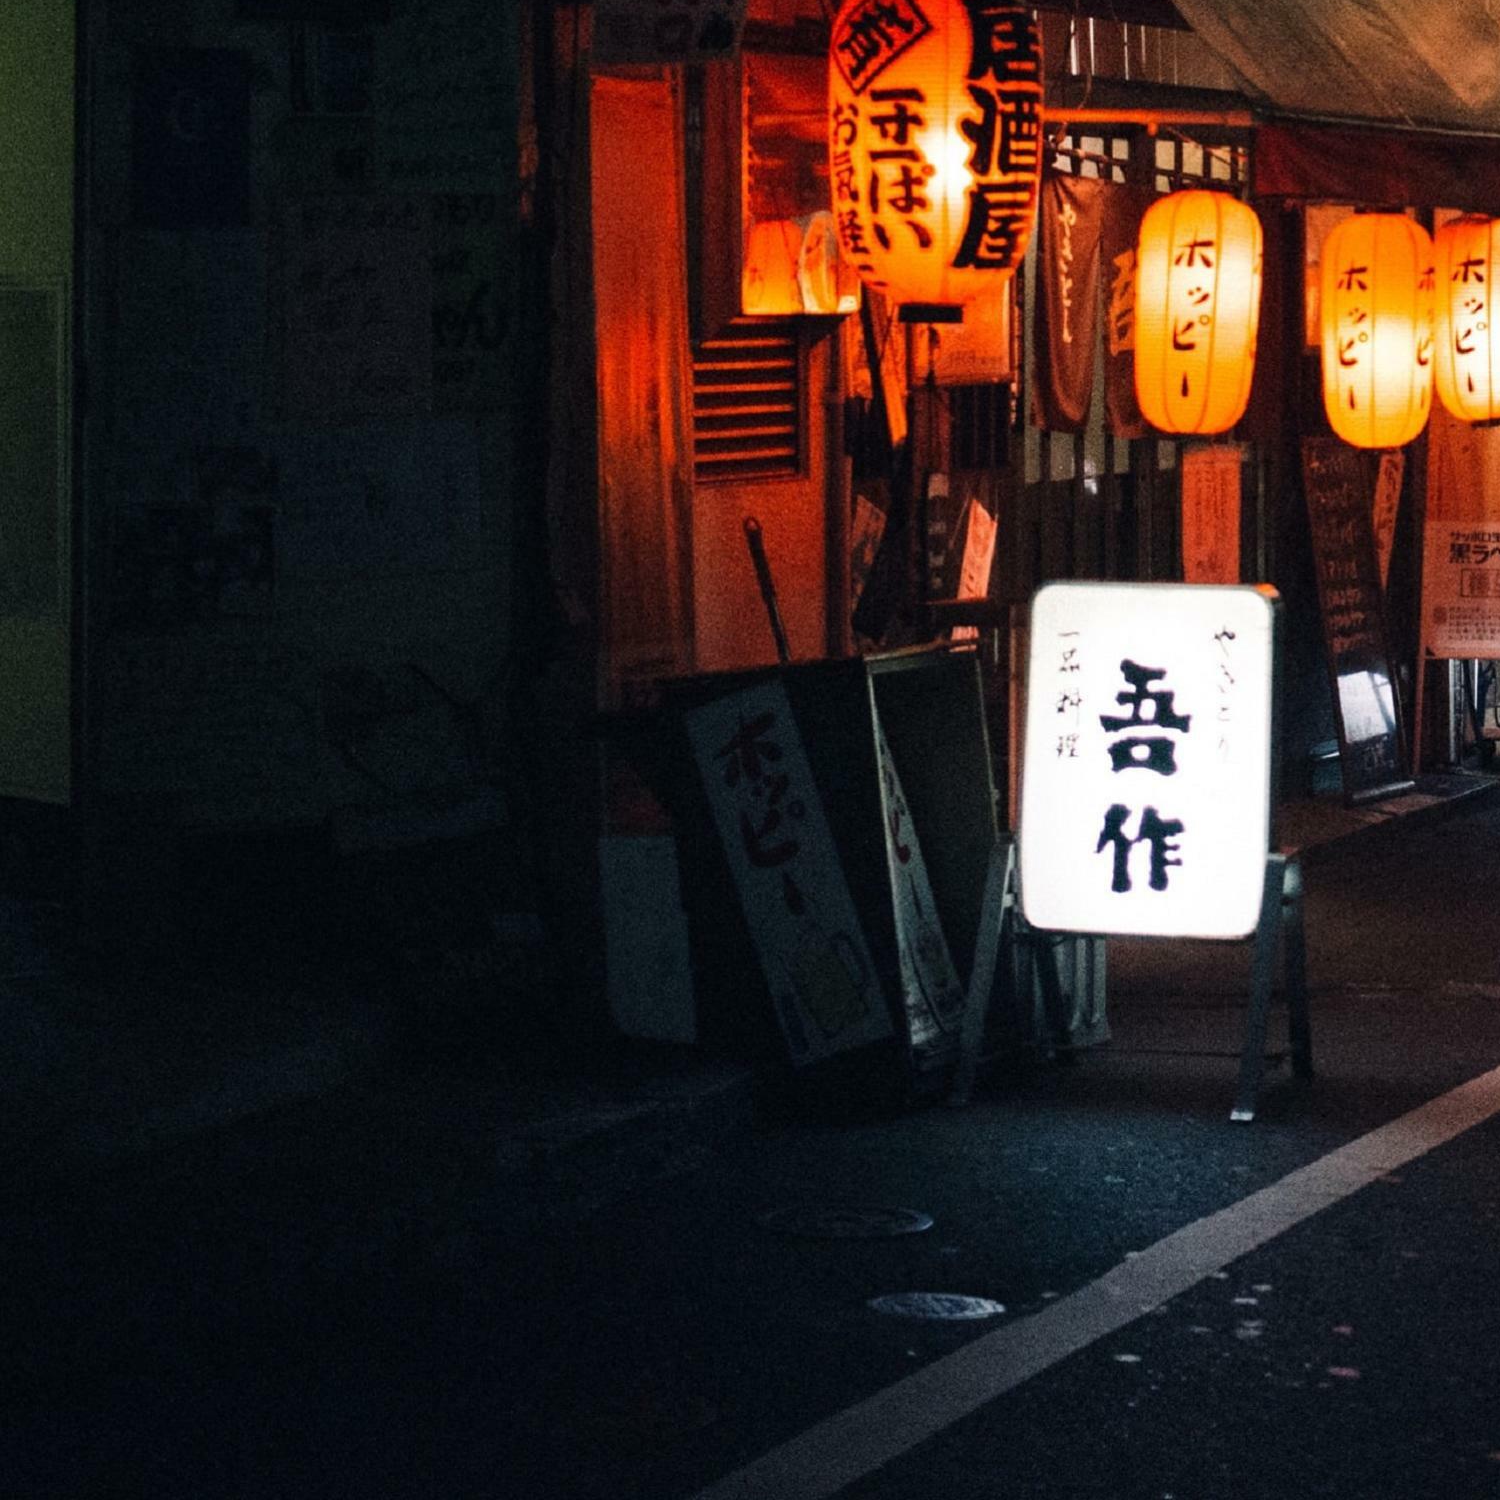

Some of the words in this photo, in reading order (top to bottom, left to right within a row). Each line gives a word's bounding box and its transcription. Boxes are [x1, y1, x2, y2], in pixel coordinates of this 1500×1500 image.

[1172, 228, 1214, 398] ホッピー
[1337, 264, 1370, 410] ホッピー
[1452, 252, 1488, 393] ホッピー
[1095, 658, 1193, 894] 吾作
